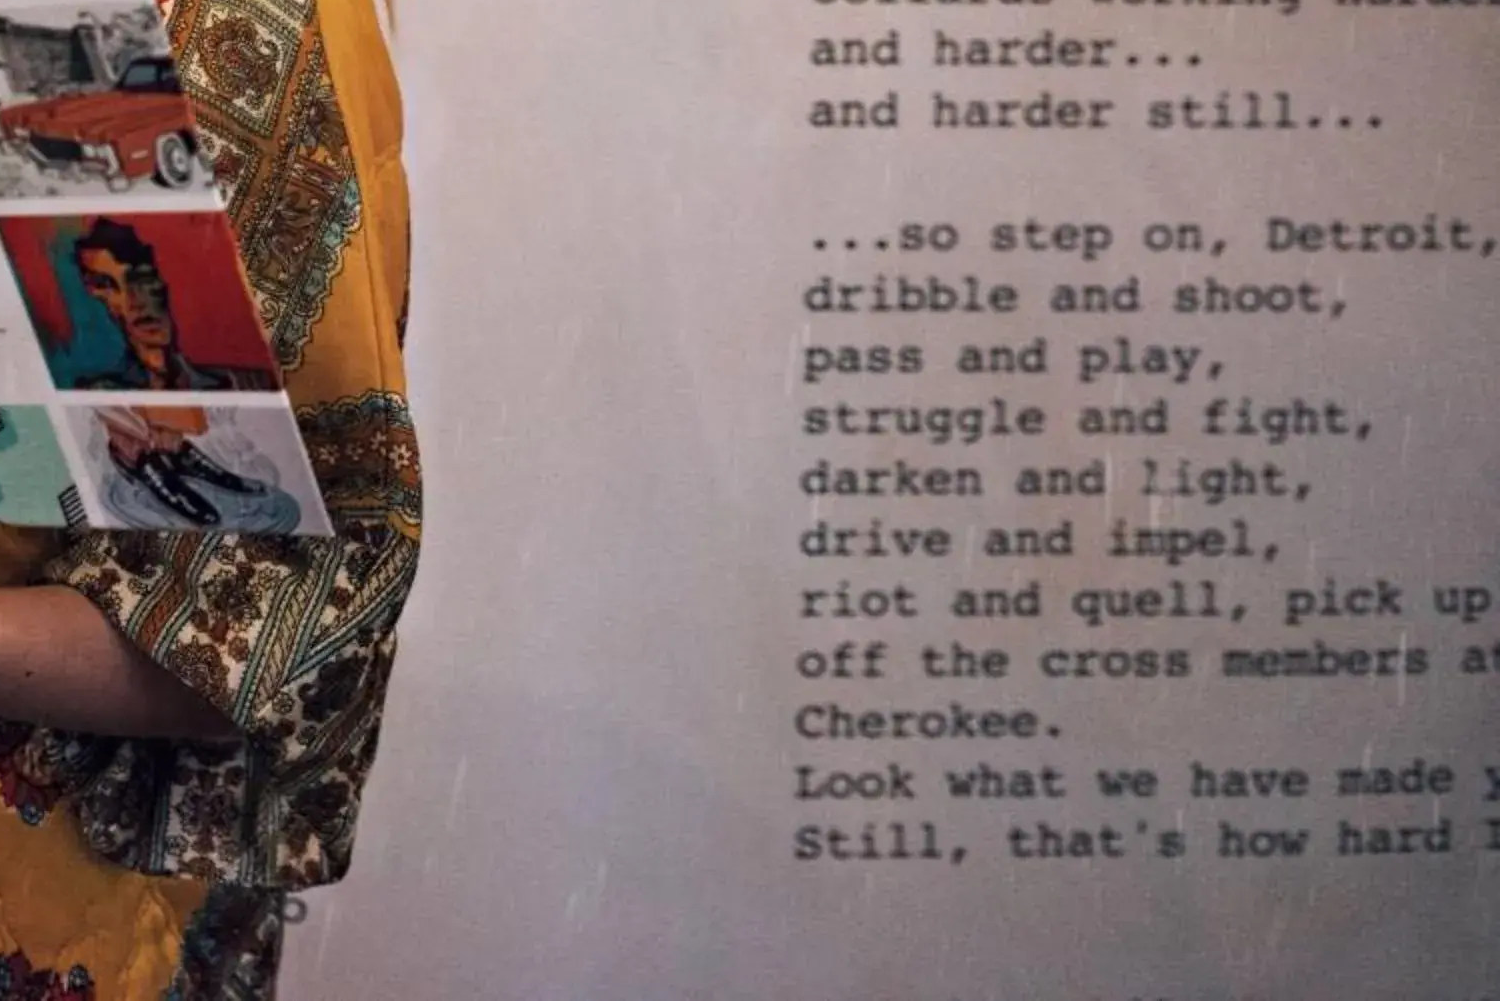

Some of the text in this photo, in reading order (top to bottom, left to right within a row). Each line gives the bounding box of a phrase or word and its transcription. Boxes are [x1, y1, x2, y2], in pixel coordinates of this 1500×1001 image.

[810, 29, 1201, 67] and harder...
[808, 91, 1381, 129] and harder still...
[813, 214, 1496, 261] ...so step on, Detroit,
[803, 275, 1346, 317] dribble and shoot,
[803, 338, 1223, 384] pass and play,
[803, 398, 1371, 444] struggle and fight,
[799, 460, 982, 496] darken
[1015, 460, 1105, 496] and
[801, 579, 1491, 627] riot and quell, pick up
[795, 704, 1060, 739] Cherokee.
[795, 764, 915, 800] Look
[945, 764, 1065, 798] what
[1096, 771, 1158, 797] we
[1191, 762, 1308, 797] have
[1338, 760, 1453, 795] made
